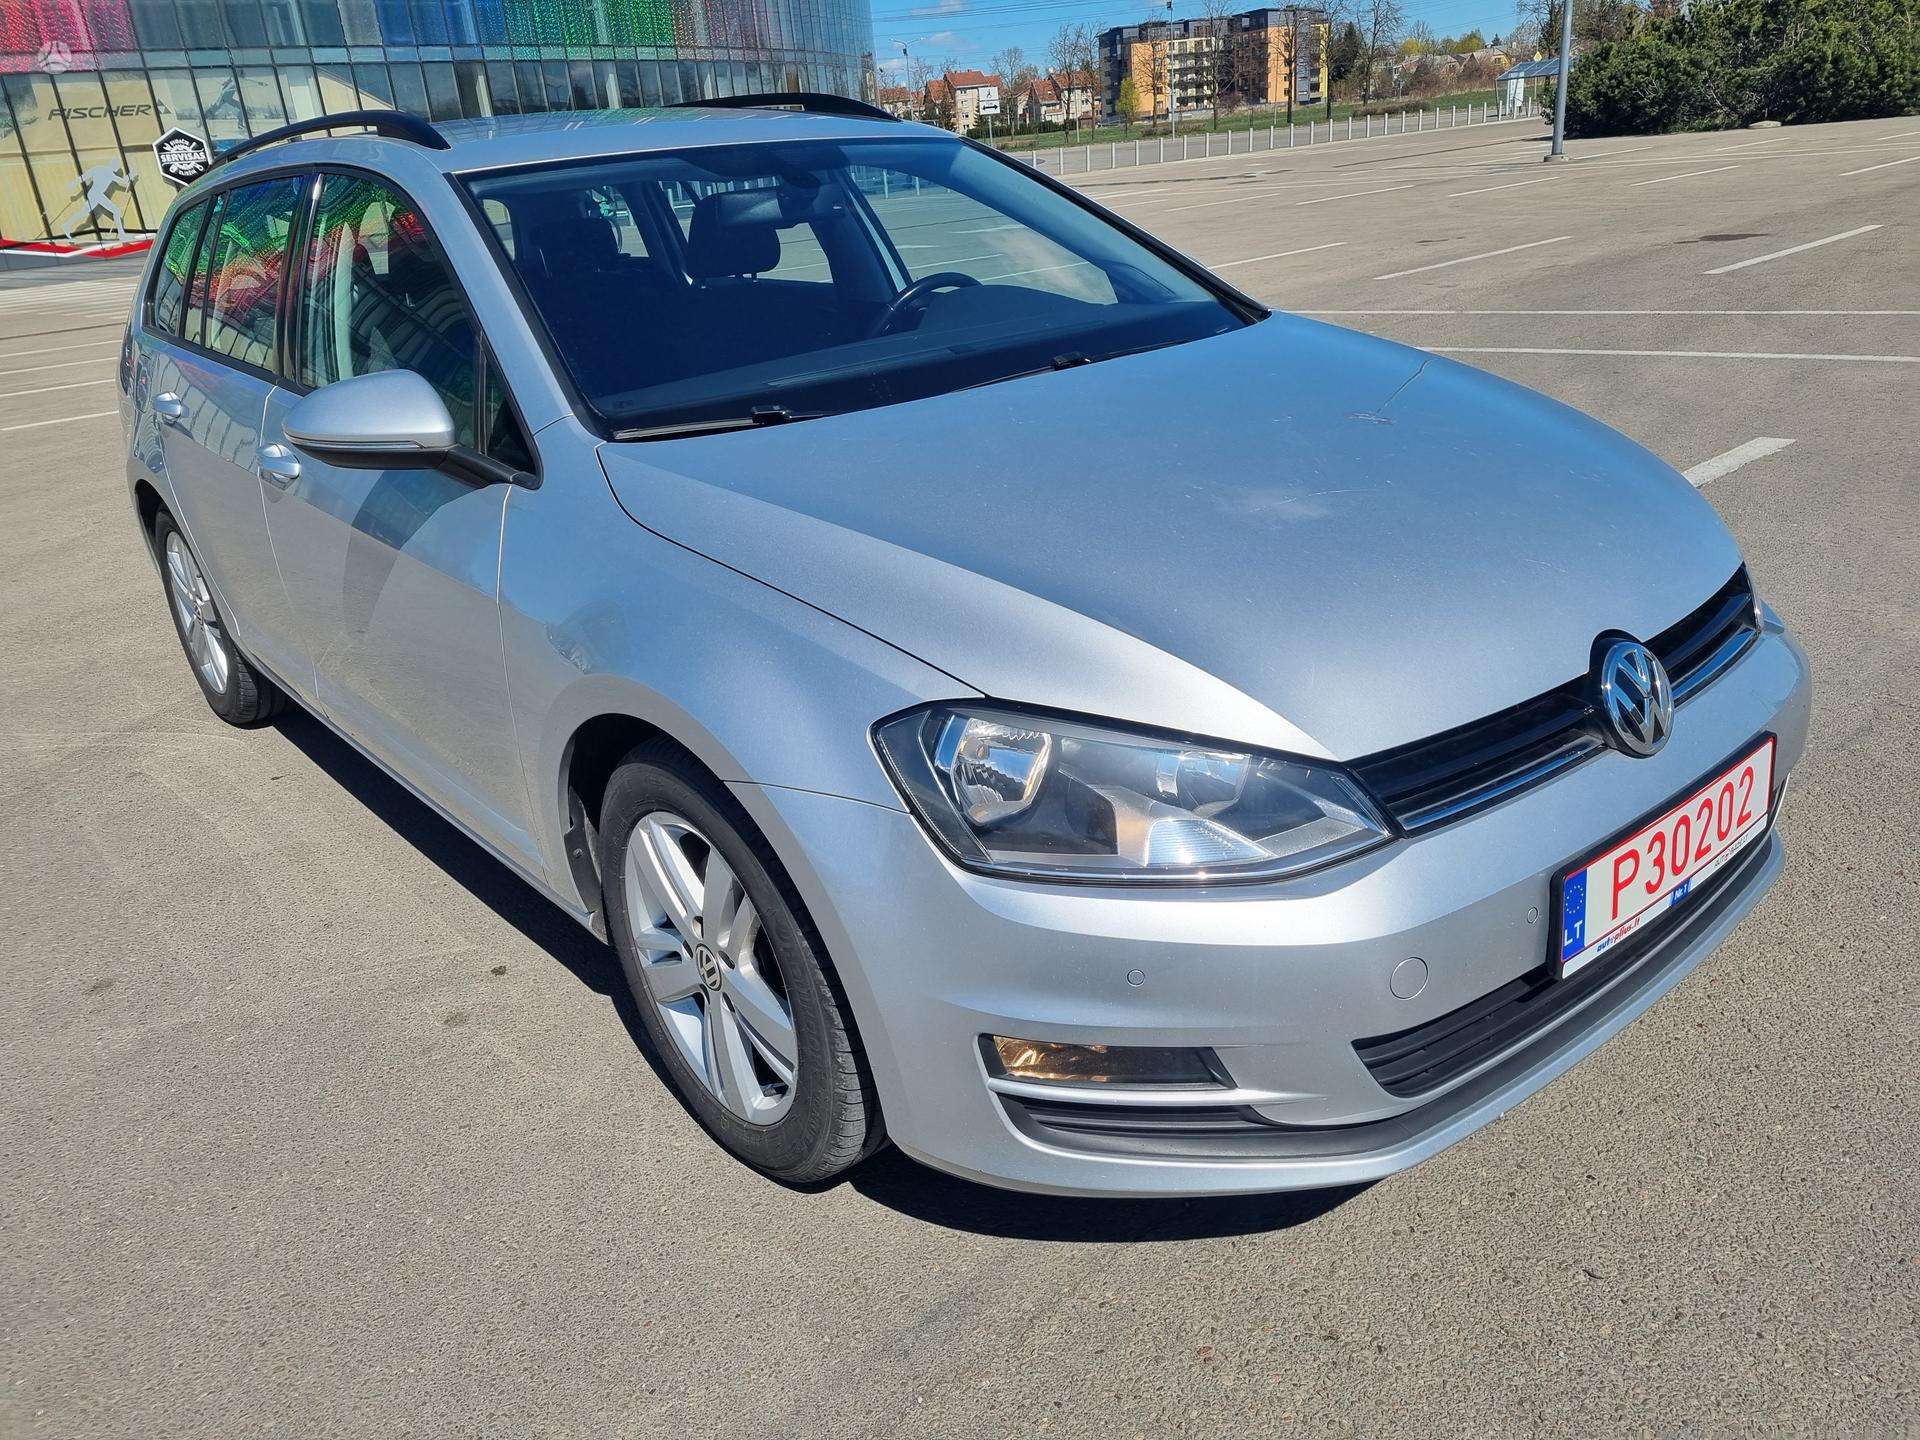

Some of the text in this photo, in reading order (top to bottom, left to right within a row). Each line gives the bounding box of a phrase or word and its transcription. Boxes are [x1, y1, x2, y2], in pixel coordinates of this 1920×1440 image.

[48, 105, 151, 120] FISCHER
[160, 152, 206, 162] SERVISAS
[1610, 766, 1754, 920] P30202
[1564, 920, 1583, 946] LT
